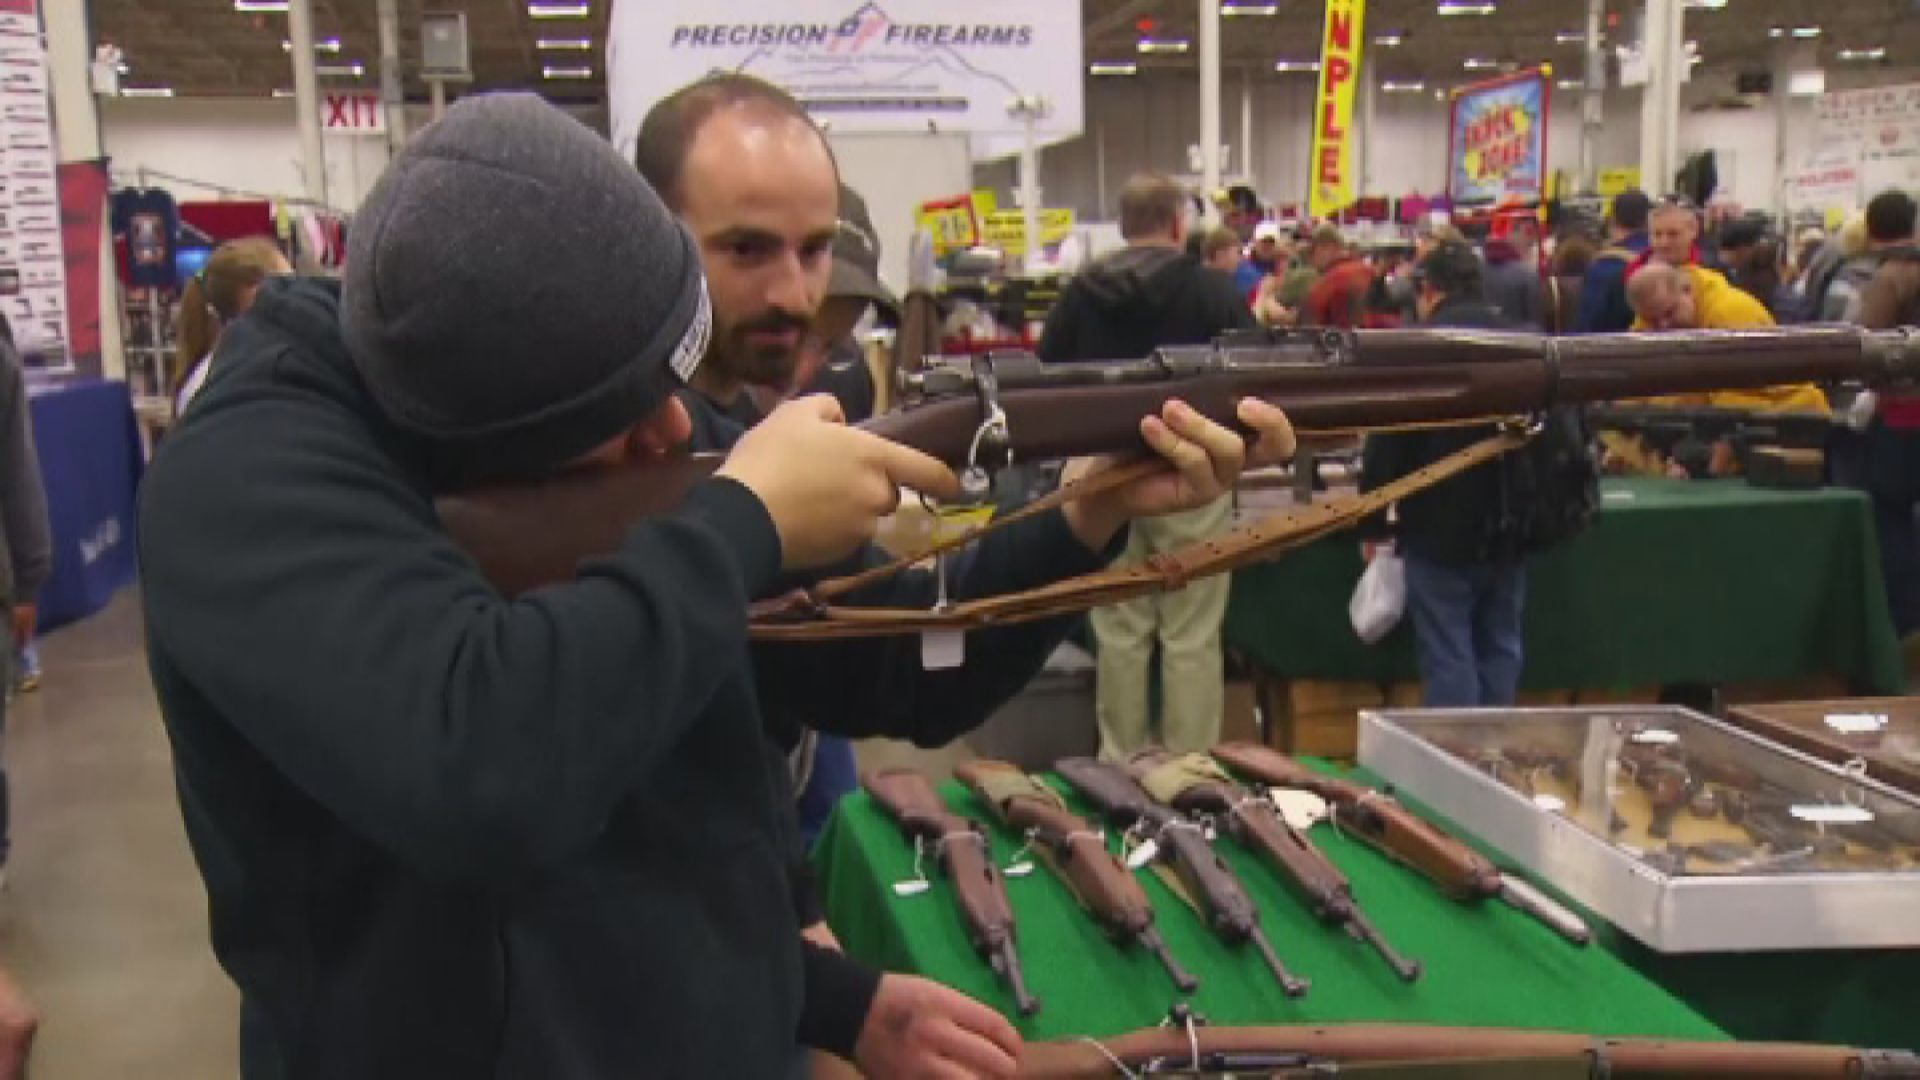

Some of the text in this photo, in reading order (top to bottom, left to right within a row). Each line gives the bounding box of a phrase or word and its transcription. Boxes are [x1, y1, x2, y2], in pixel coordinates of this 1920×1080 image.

[671, 24, 1034, 48] PRECISION FIREARMS
[326, 92, 378, 128] XIT
